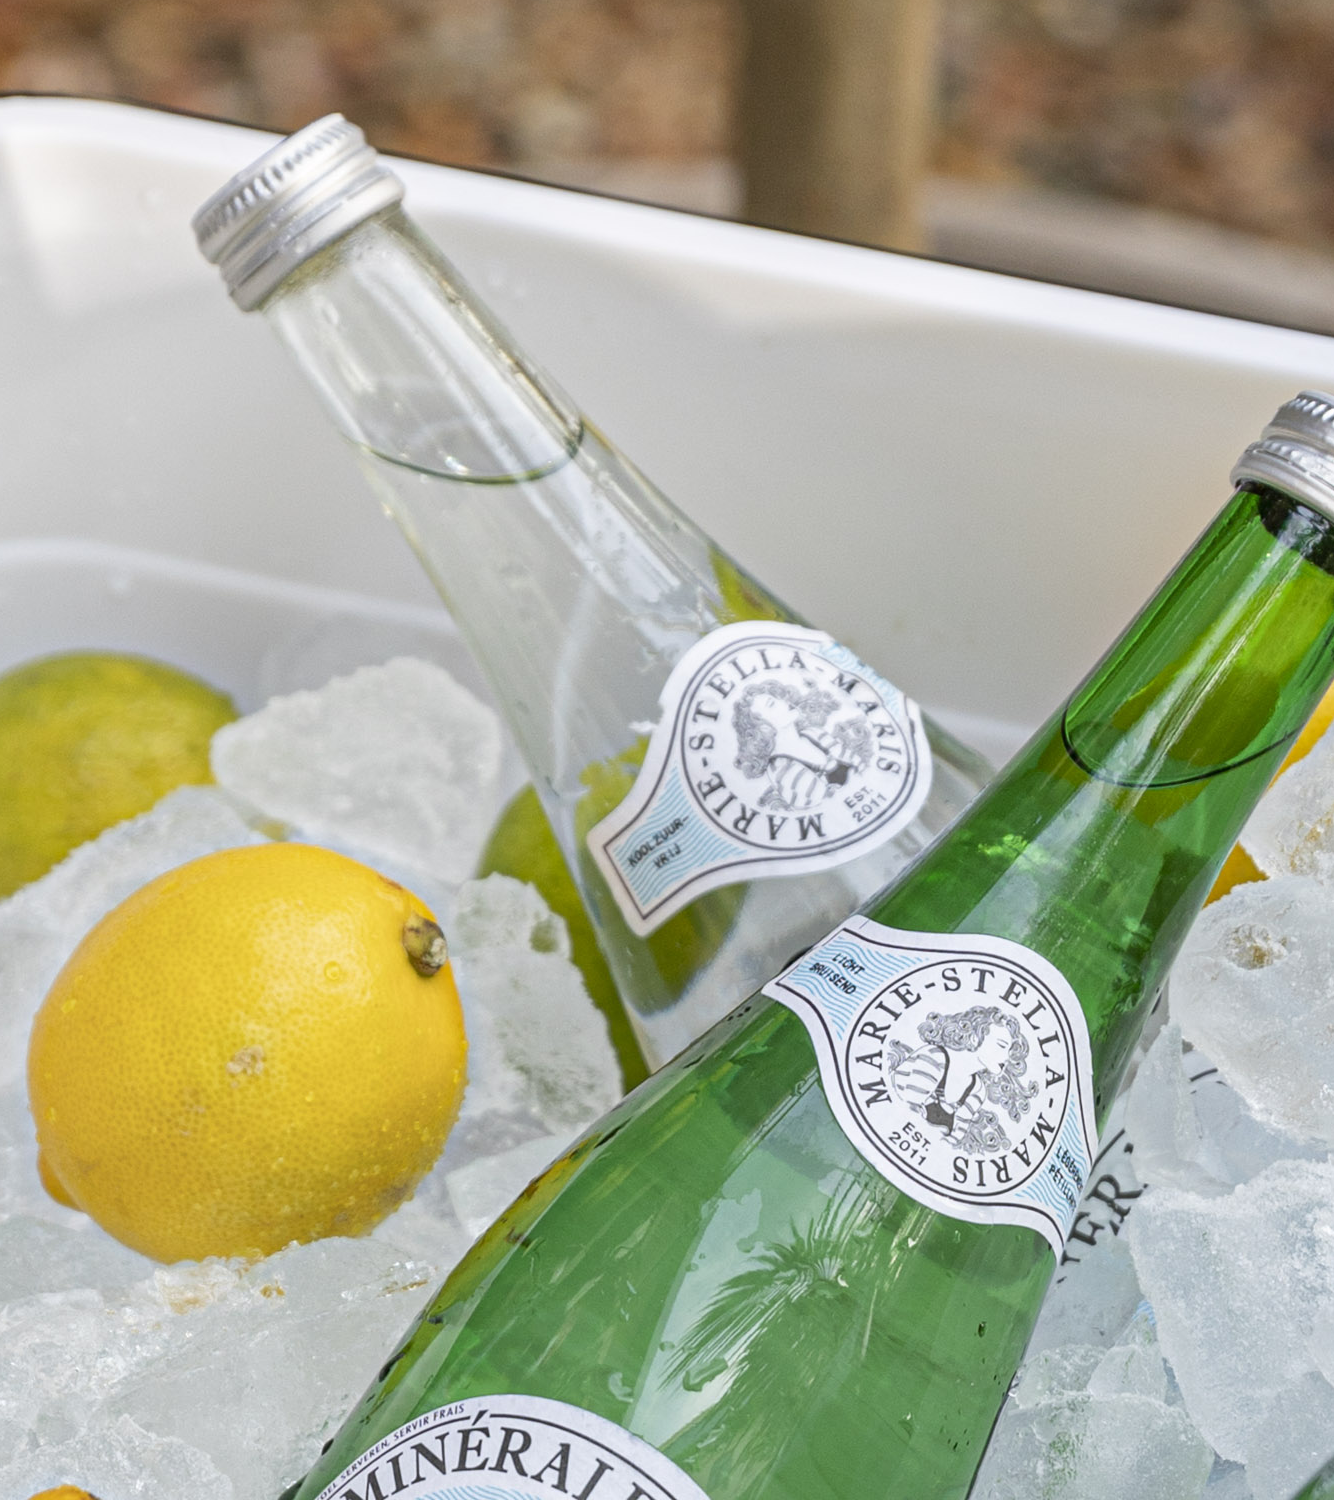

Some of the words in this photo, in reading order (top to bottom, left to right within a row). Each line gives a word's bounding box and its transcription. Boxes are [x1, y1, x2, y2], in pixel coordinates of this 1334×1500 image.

[688, 648, 903, 841] MARIE-STELLA-MARIS
[851, 793, 888, 824] 2011
[855, 967, 1066, 1186] MARIE-STELLA-MARIS
[889, 1130, 928, 1166] 2011
[393, 1417, 430, 1442] SERVIR
[432, 1403, 465, 1422] FRAIS
